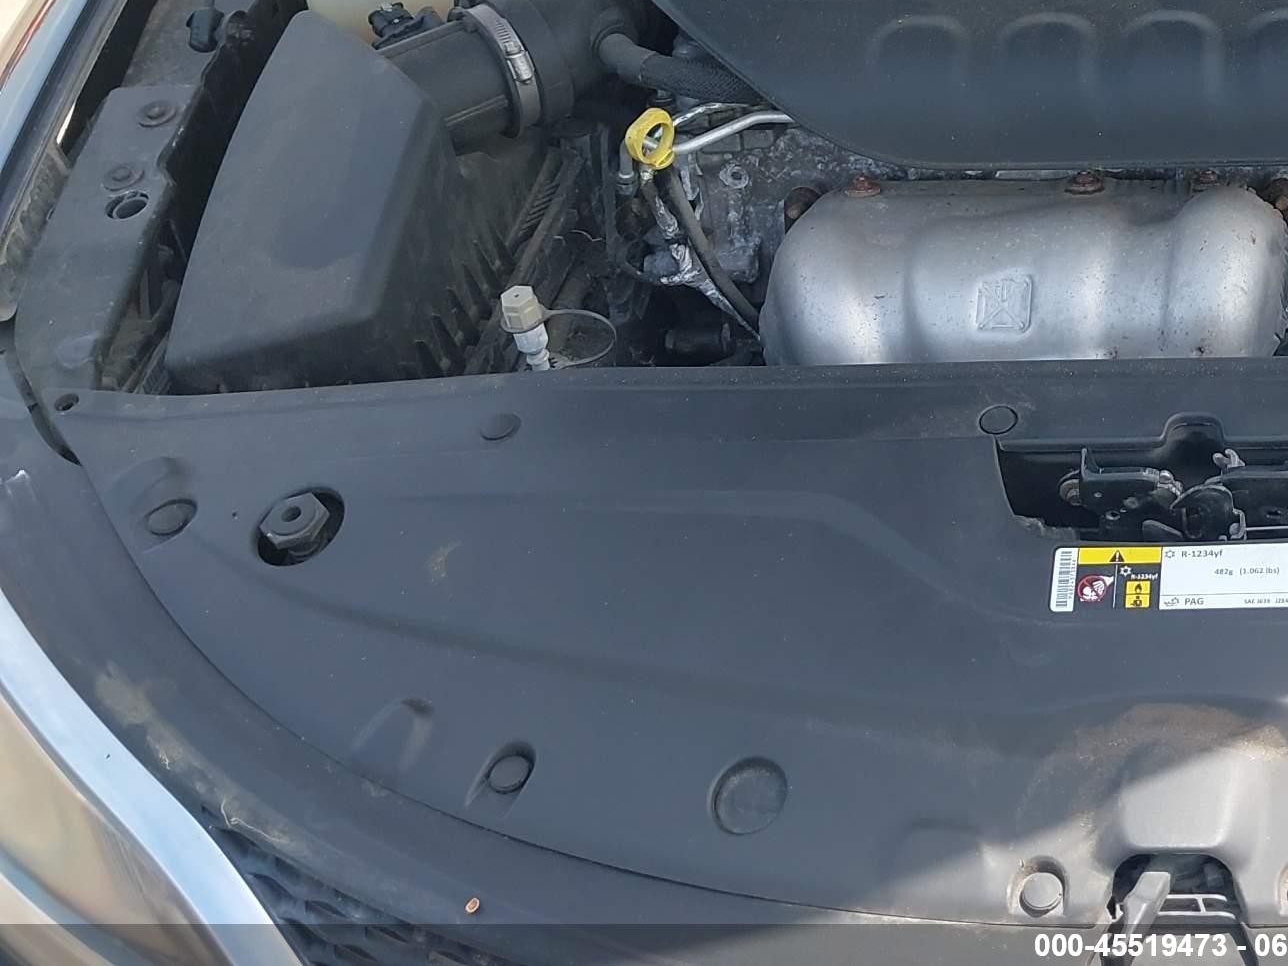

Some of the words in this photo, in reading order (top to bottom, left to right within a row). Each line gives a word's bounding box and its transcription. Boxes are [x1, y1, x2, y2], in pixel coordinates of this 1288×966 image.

[1181, 549, 1223, 558] R-1234yf
[1214, 568, 1234, 576] 482g
[1184, 597, 1204, 606] PAG
